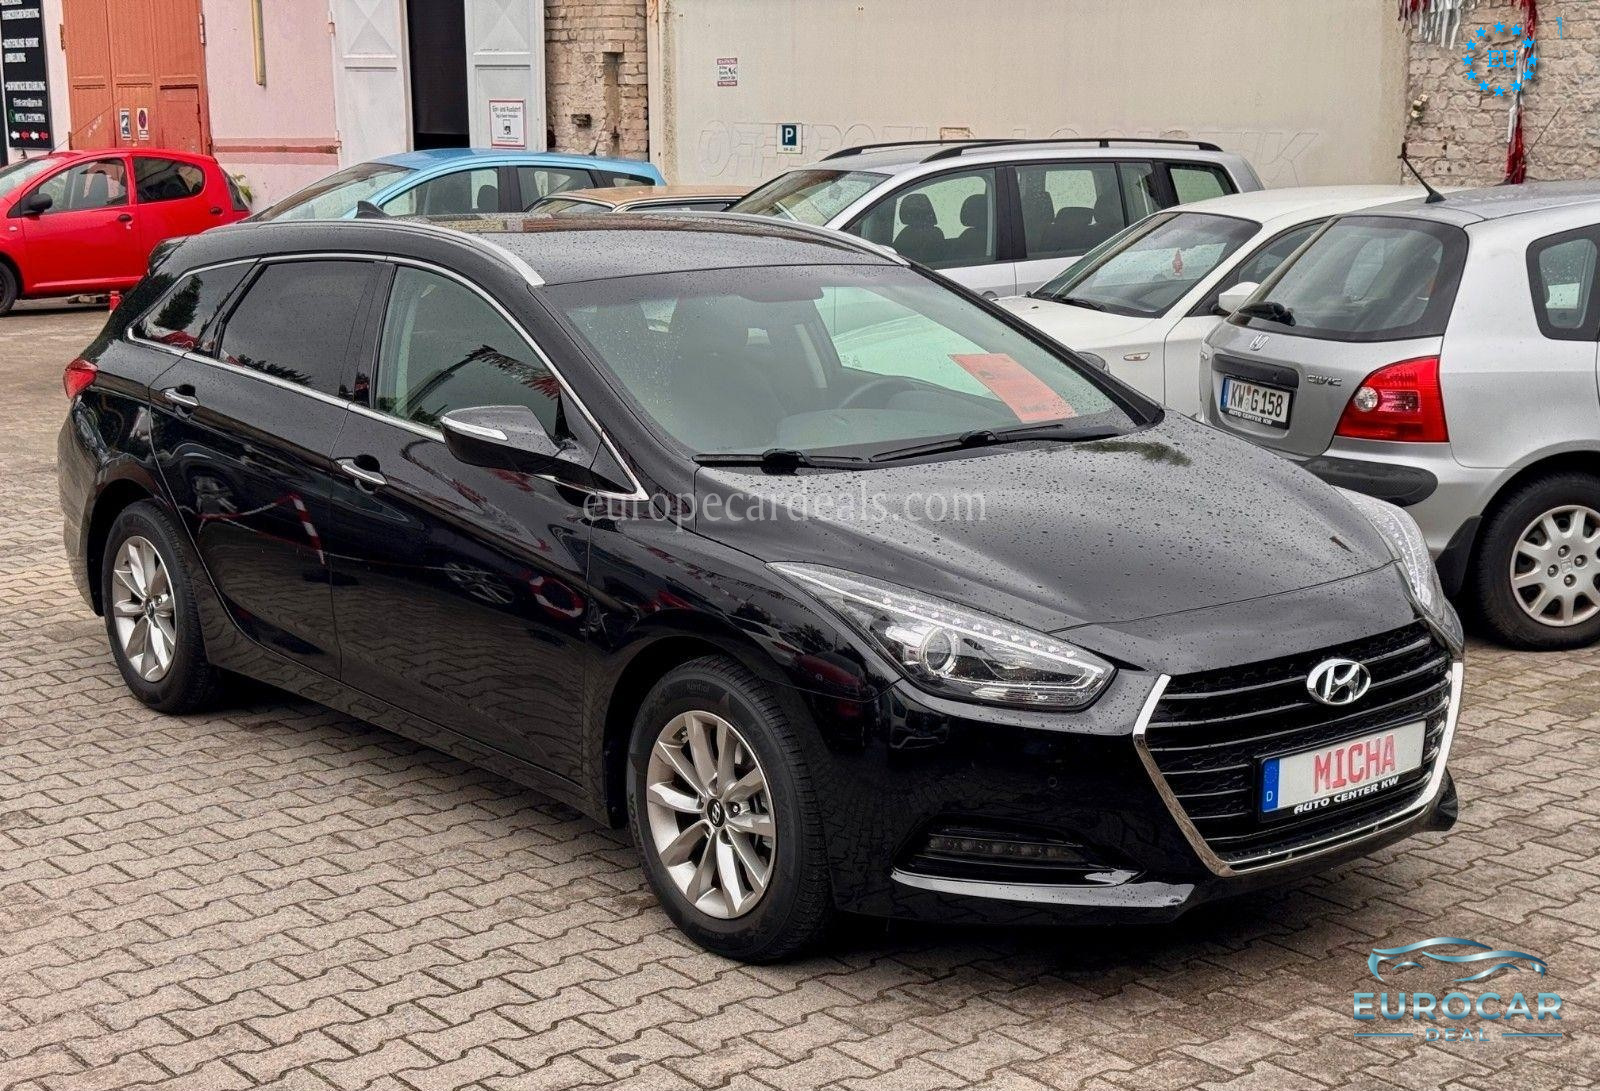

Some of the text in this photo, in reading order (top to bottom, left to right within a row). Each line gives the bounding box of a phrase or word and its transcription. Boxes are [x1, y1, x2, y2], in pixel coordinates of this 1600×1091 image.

[784, 127, 795, 143] P
[1231, 383, 1246, 409] KW
[1242, 411, 1263, 423] CENTER
[1313, 735, 1396, 794] MICHA
[1266, 790, 1274, 803] D
[1294, 776, 1400, 815] AUTO CENTER KW
